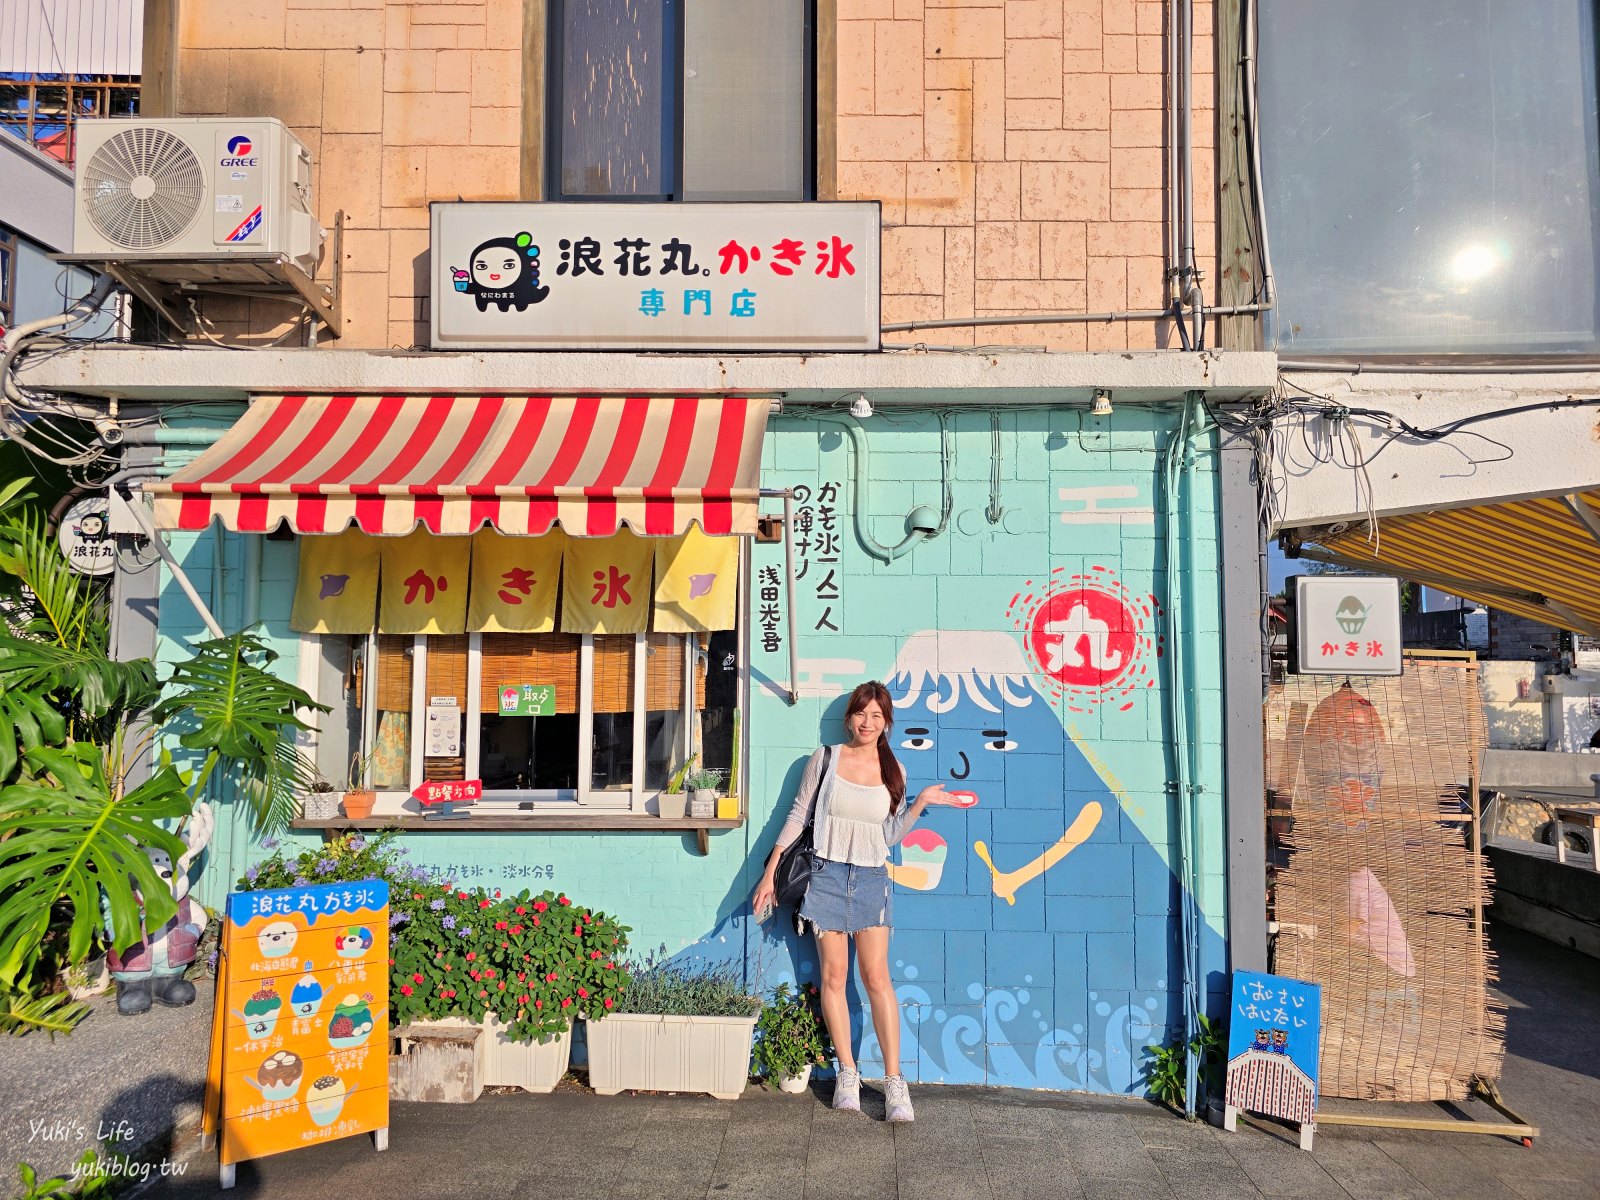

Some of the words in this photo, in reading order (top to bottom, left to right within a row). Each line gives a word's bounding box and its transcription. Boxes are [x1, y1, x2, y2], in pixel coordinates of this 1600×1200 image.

[220, 158, 258, 167] GREE
[638, 288, 758, 317] 専門店
[74, 545, 114, 557] 浪花丸
[403, 565, 633, 609] かき氷
[758, 563, 783, 653] 浅田光喜
[1044, 600, 1122, 673] 丸
[1320, 640, 1384, 657] かき氷
